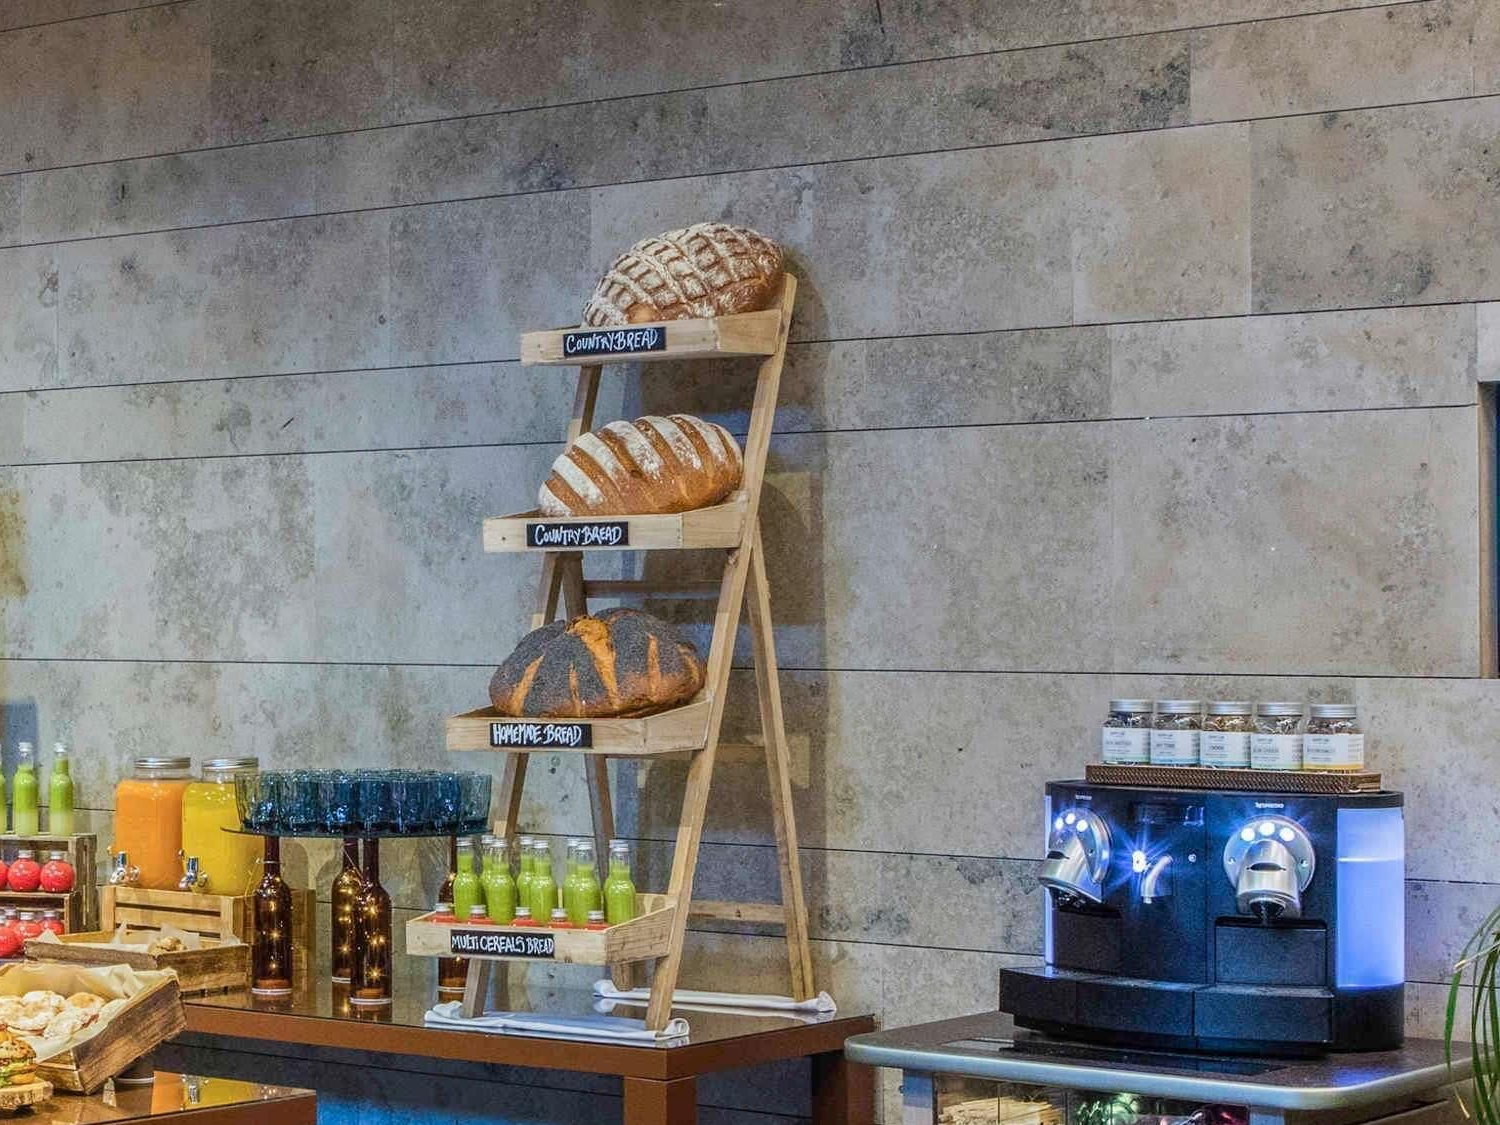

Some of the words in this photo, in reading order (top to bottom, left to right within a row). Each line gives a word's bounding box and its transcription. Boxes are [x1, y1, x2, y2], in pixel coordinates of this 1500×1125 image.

[613, 328, 658, 350] BREAD
[581, 526, 622, 545] BREAD
[543, 724, 582, 747] BREAD
[451, 934, 479, 950] MULTI
[480, 935, 526, 953] CEREALS
[526, 937, 555, 955] BREAD
